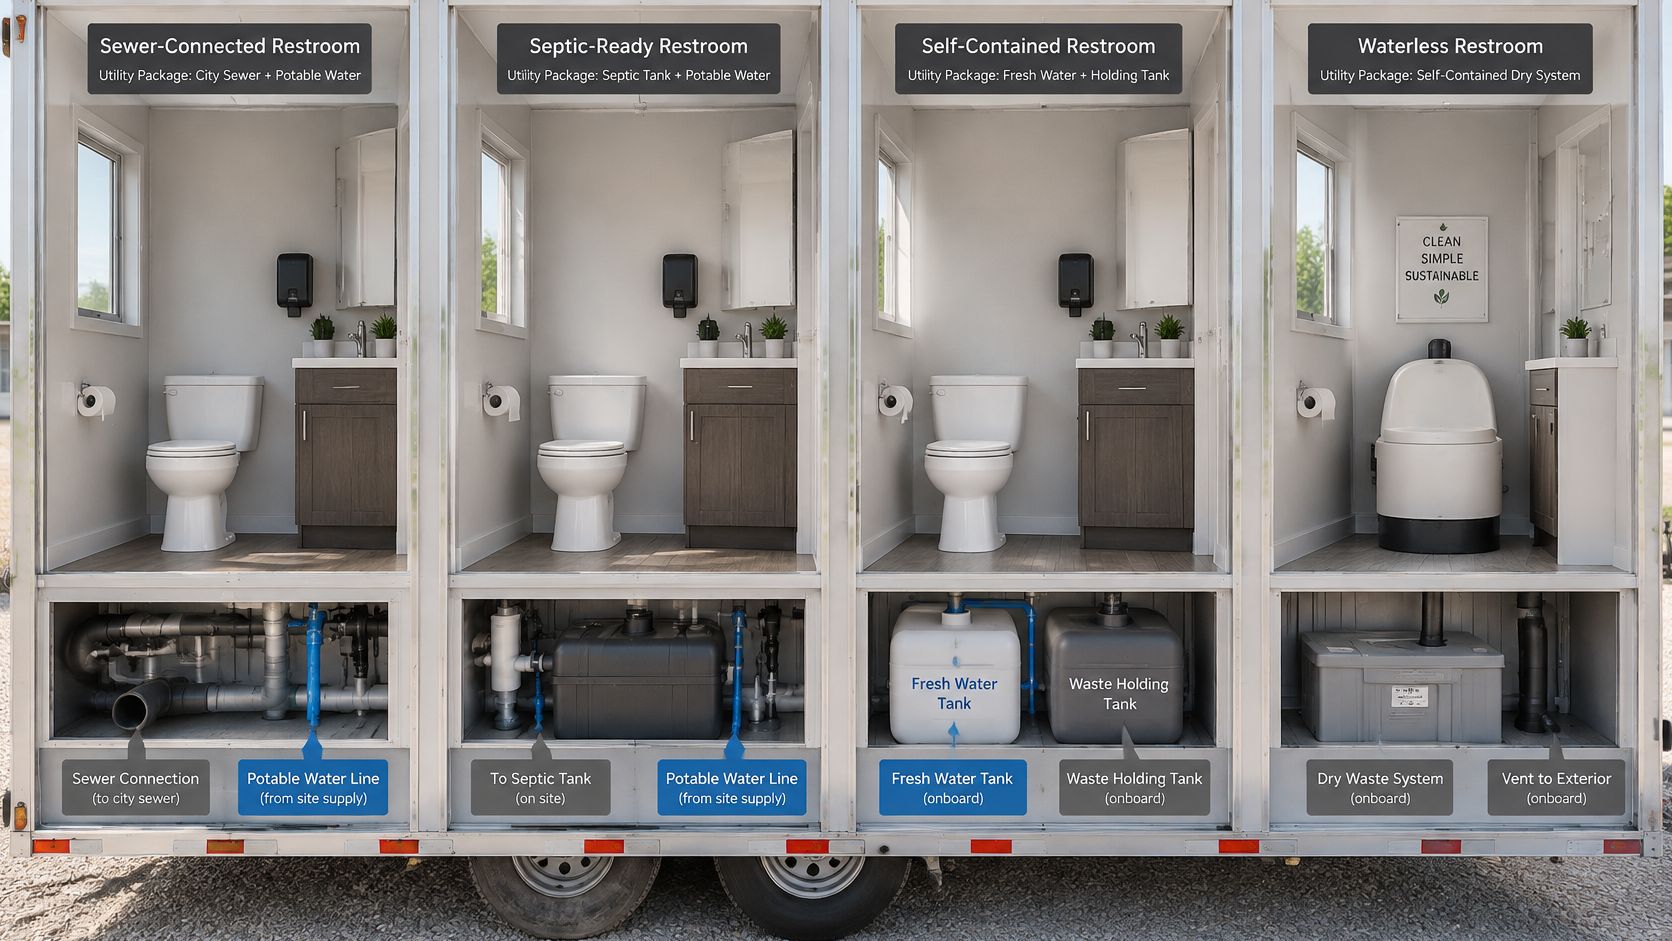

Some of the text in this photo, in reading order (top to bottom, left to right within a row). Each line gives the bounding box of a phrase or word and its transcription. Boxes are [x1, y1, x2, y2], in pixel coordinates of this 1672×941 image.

[1422, 235, 1461, 248] CLEAN
[1421, 252, 1464, 265] SIMPLE
[1405, 270, 1480, 282] SUSTAINABLE
